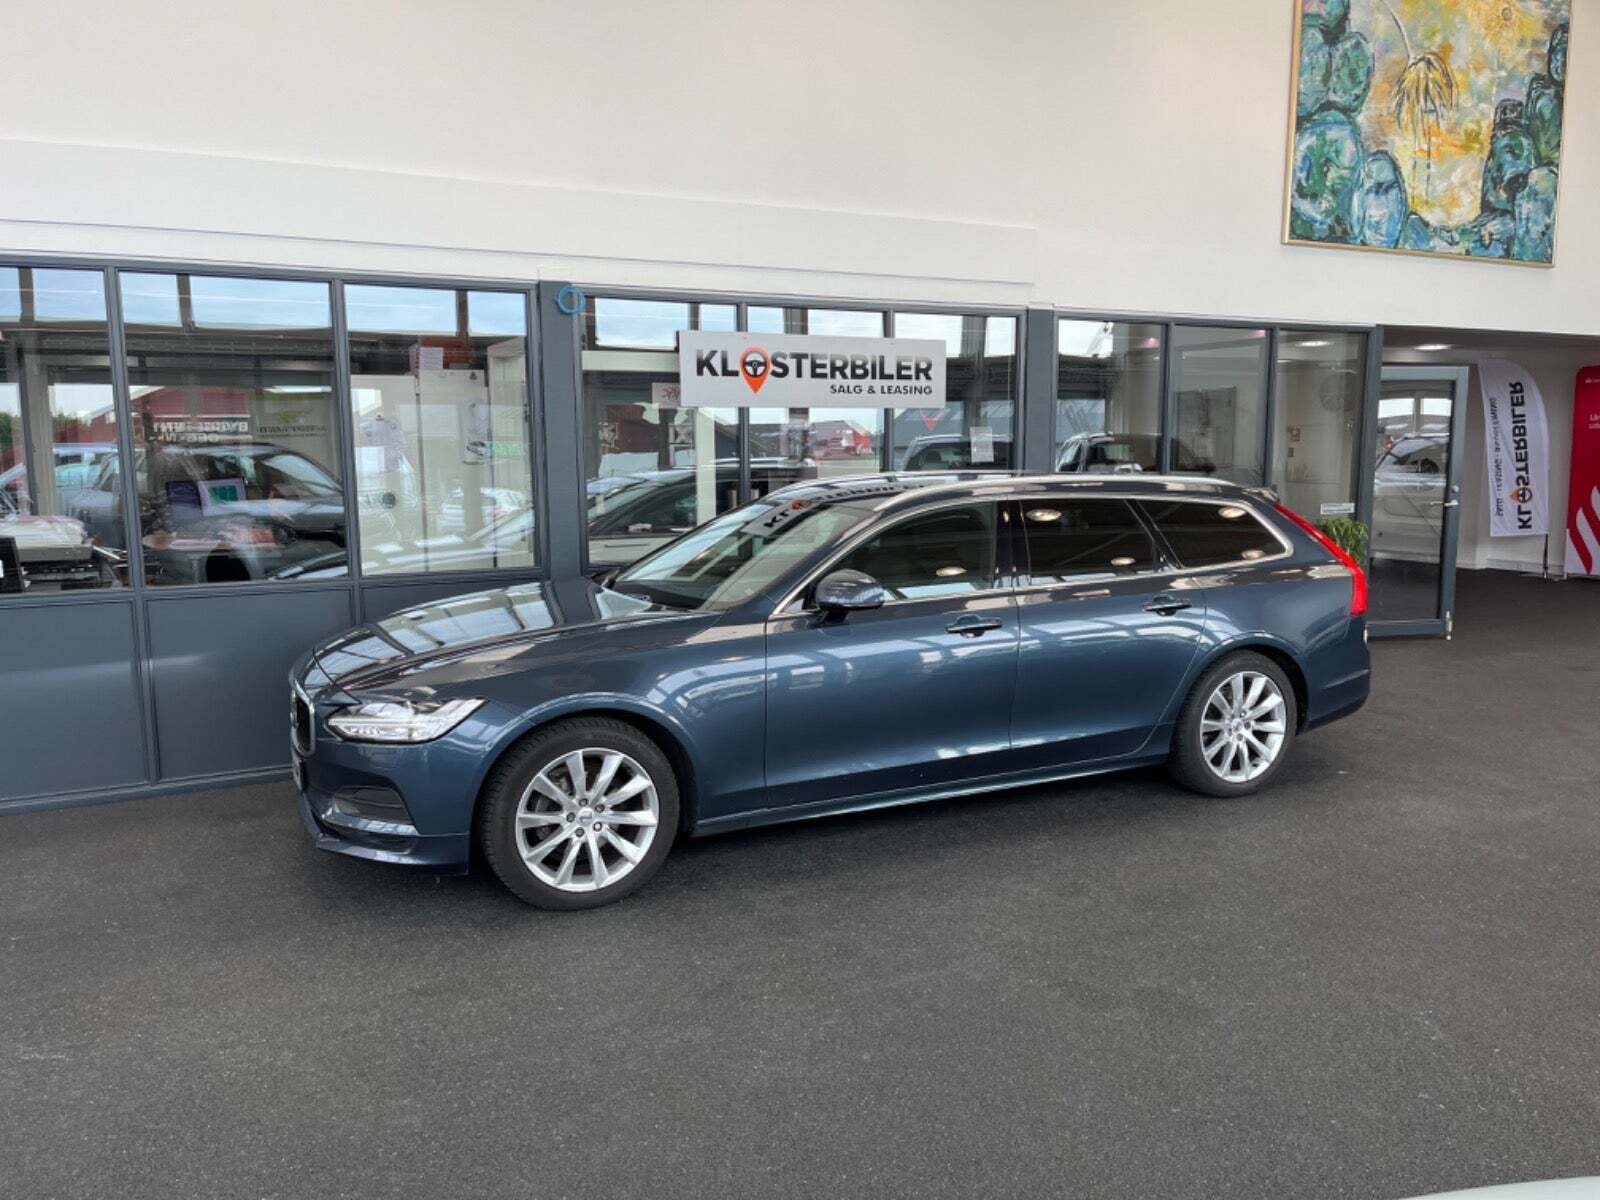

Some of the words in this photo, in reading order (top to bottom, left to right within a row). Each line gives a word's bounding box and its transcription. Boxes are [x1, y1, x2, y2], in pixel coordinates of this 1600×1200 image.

[696, 348, 933, 382] KLOSTERBILER
[830, 384, 863, 395] SALG
[867, 384, 877, 395] &
[881, 384, 933, 396] LEASING
